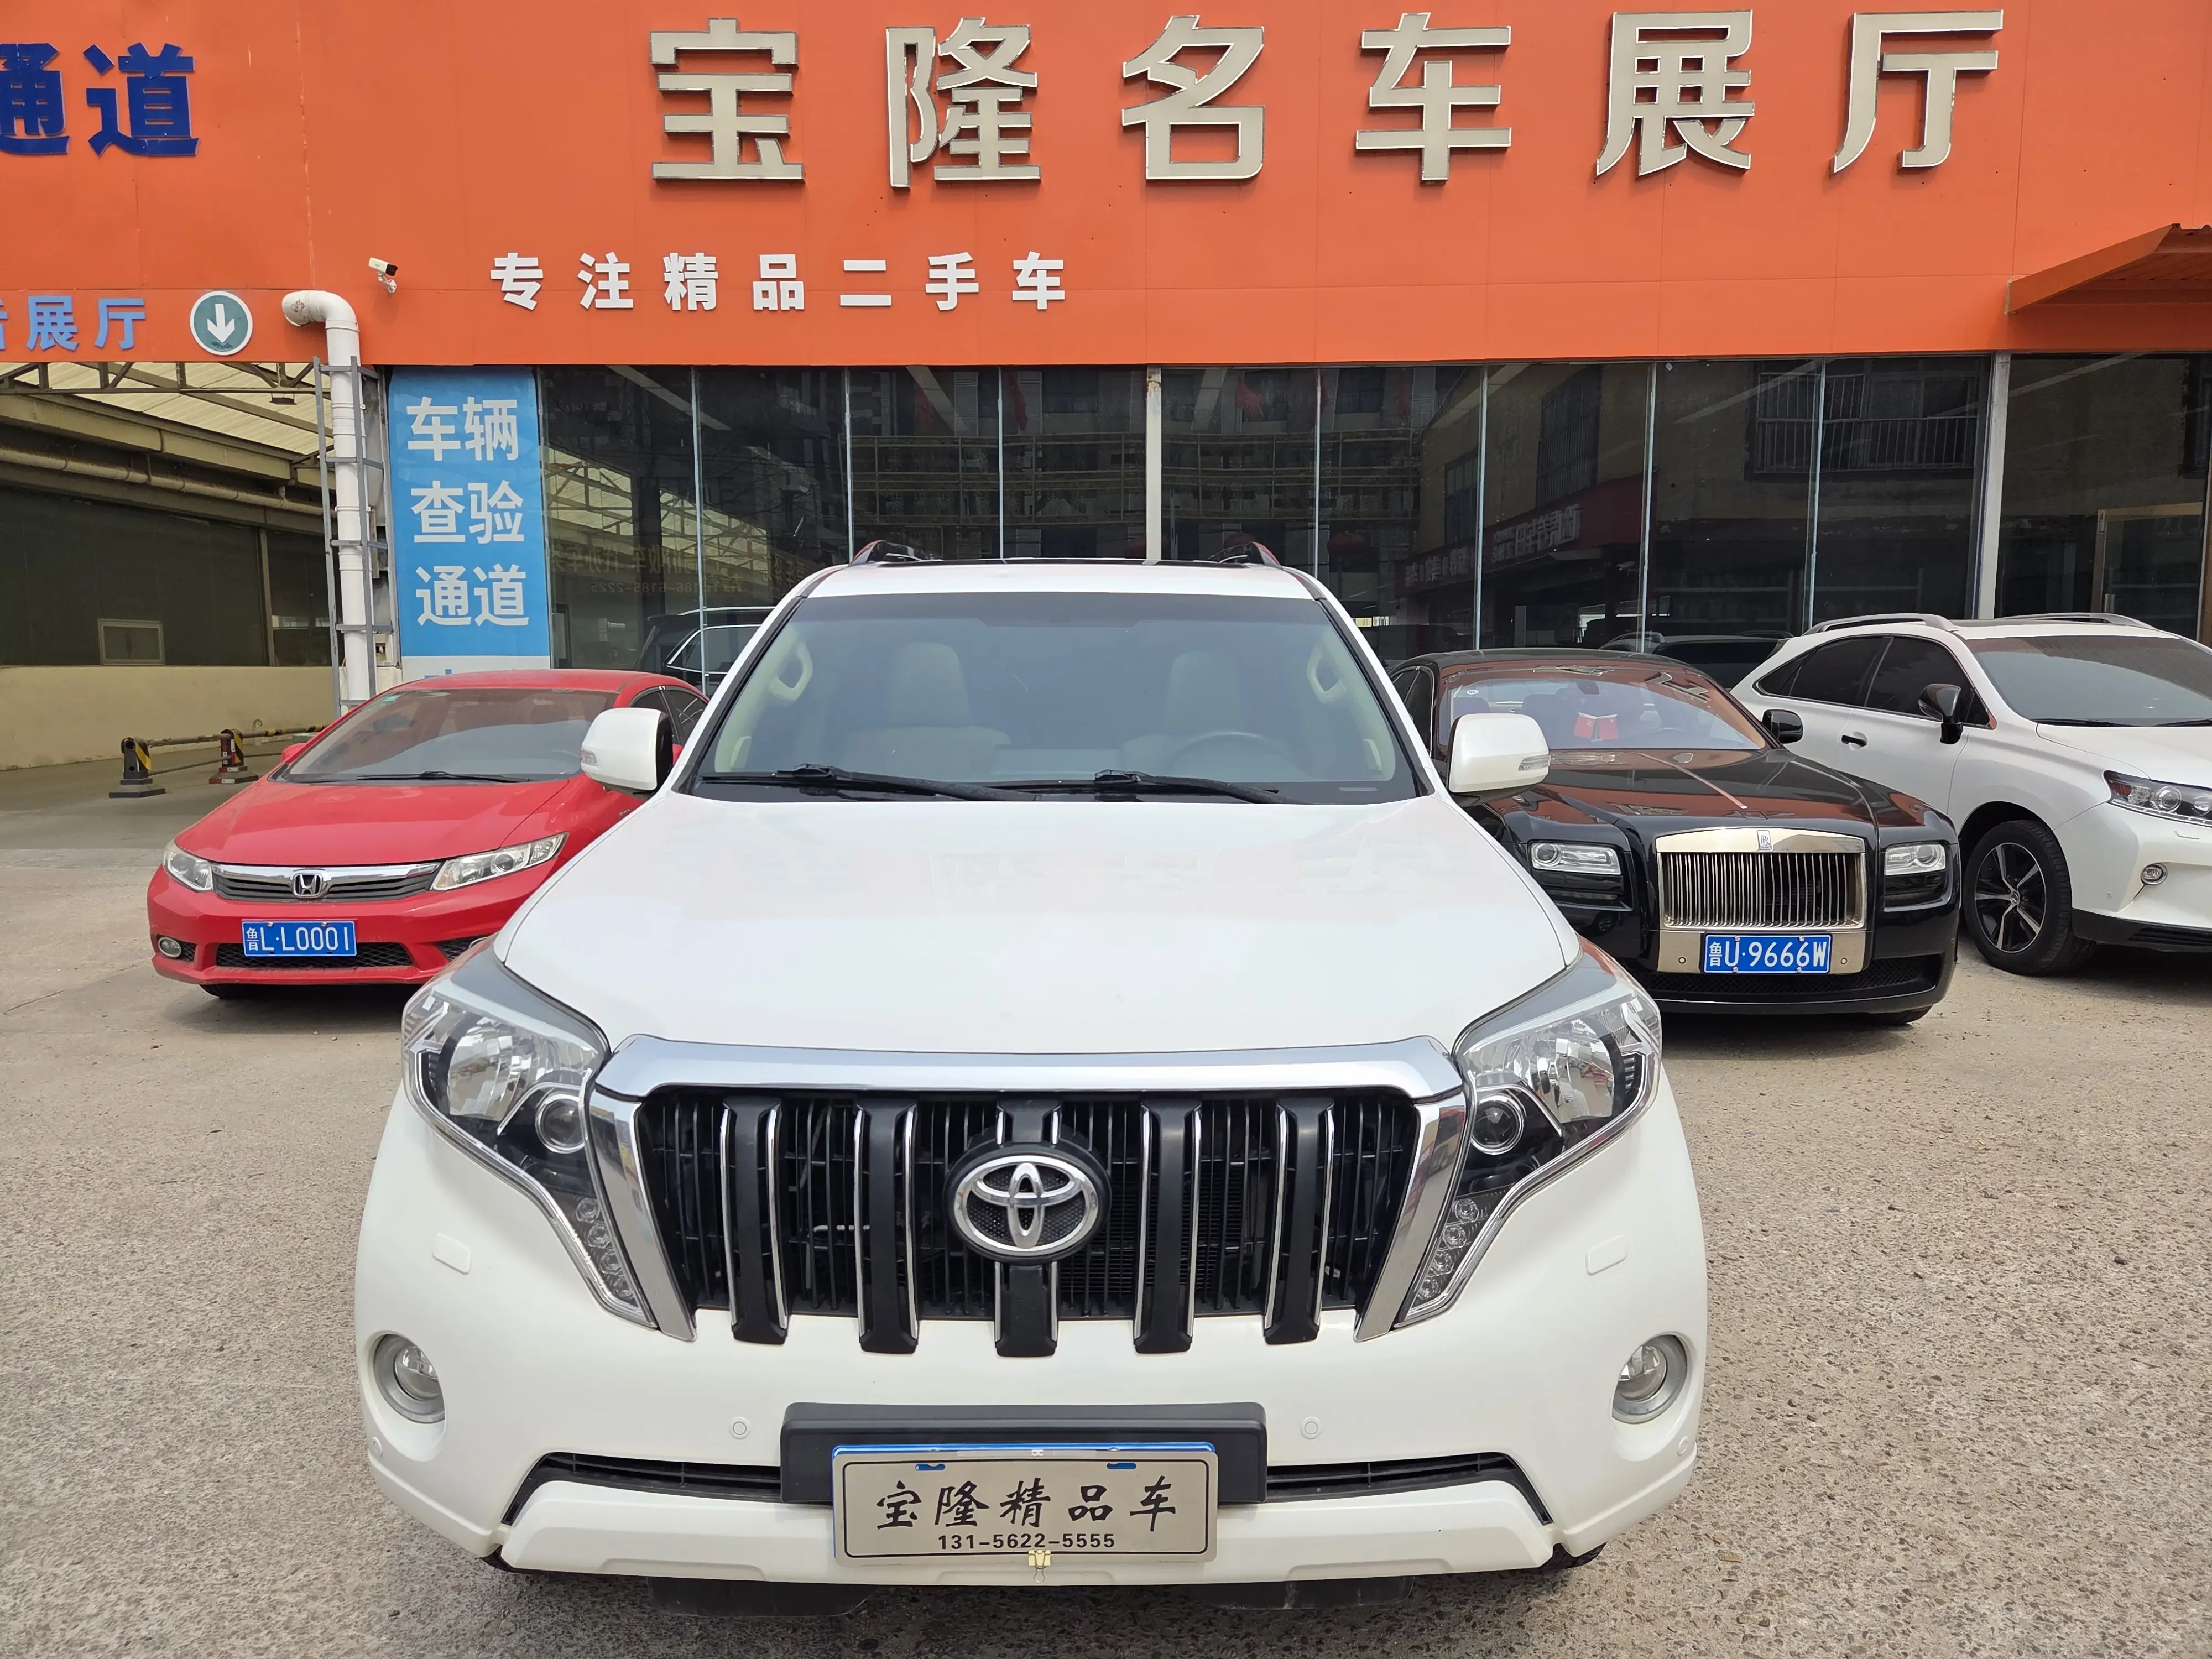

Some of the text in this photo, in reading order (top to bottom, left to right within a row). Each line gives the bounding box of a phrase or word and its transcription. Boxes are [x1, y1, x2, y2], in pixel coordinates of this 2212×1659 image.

[0, 42, 200, 157] 通道
[649, 9, 2004, 190] 宝隆名车展厅
[490, 251, 1066, 311] 专注精品二手车
[0, 295, 146, 352] 展厅
[406, 396, 519, 462] 车辆
[410, 480, 524, 544] 查验
[415, 564, 529, 627] 通道
[876, 1476, 1177, 1532] 宝隆精品车
[938, 1533, 1115, 1550] 131-5622-5555
